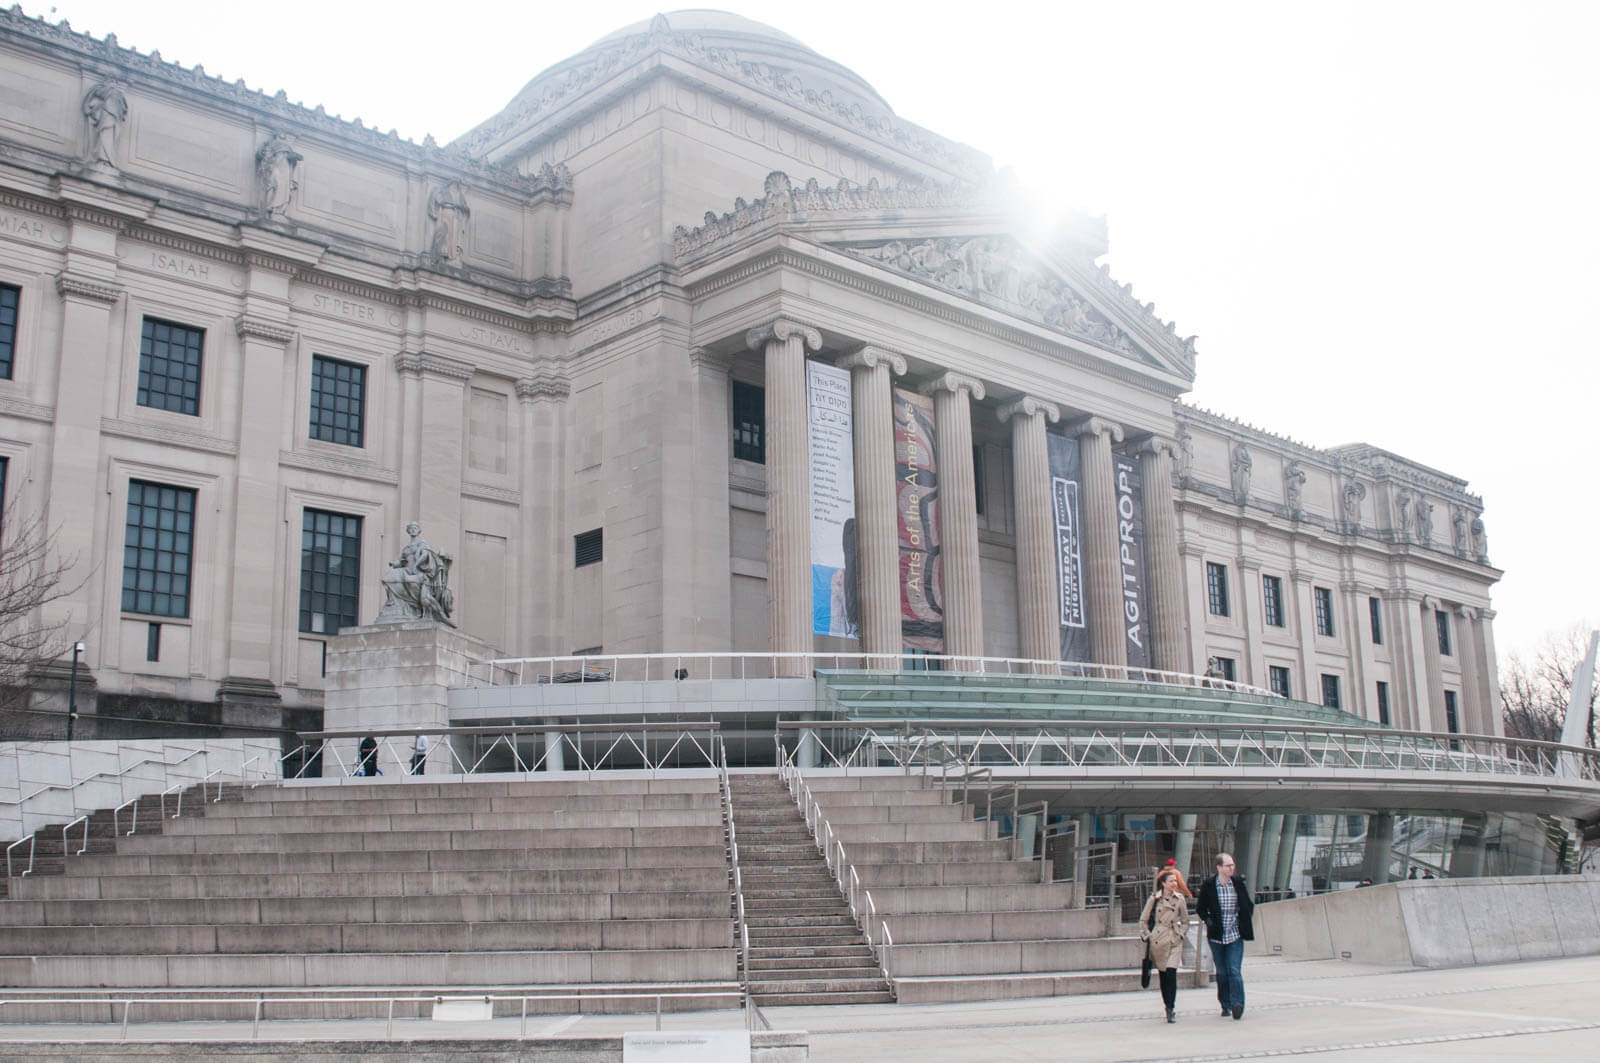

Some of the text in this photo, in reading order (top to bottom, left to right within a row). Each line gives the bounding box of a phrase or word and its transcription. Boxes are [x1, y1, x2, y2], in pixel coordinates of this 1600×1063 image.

[152, 253, 209, 282] ISAIAH
[812, 375, 848, 393] This Place
[904, 399, 920, 592] Arts of the Americas
[1062, 535, 1071, 616] THURSDAY
[1118, 463, 1142, 648] AGITPROP!
